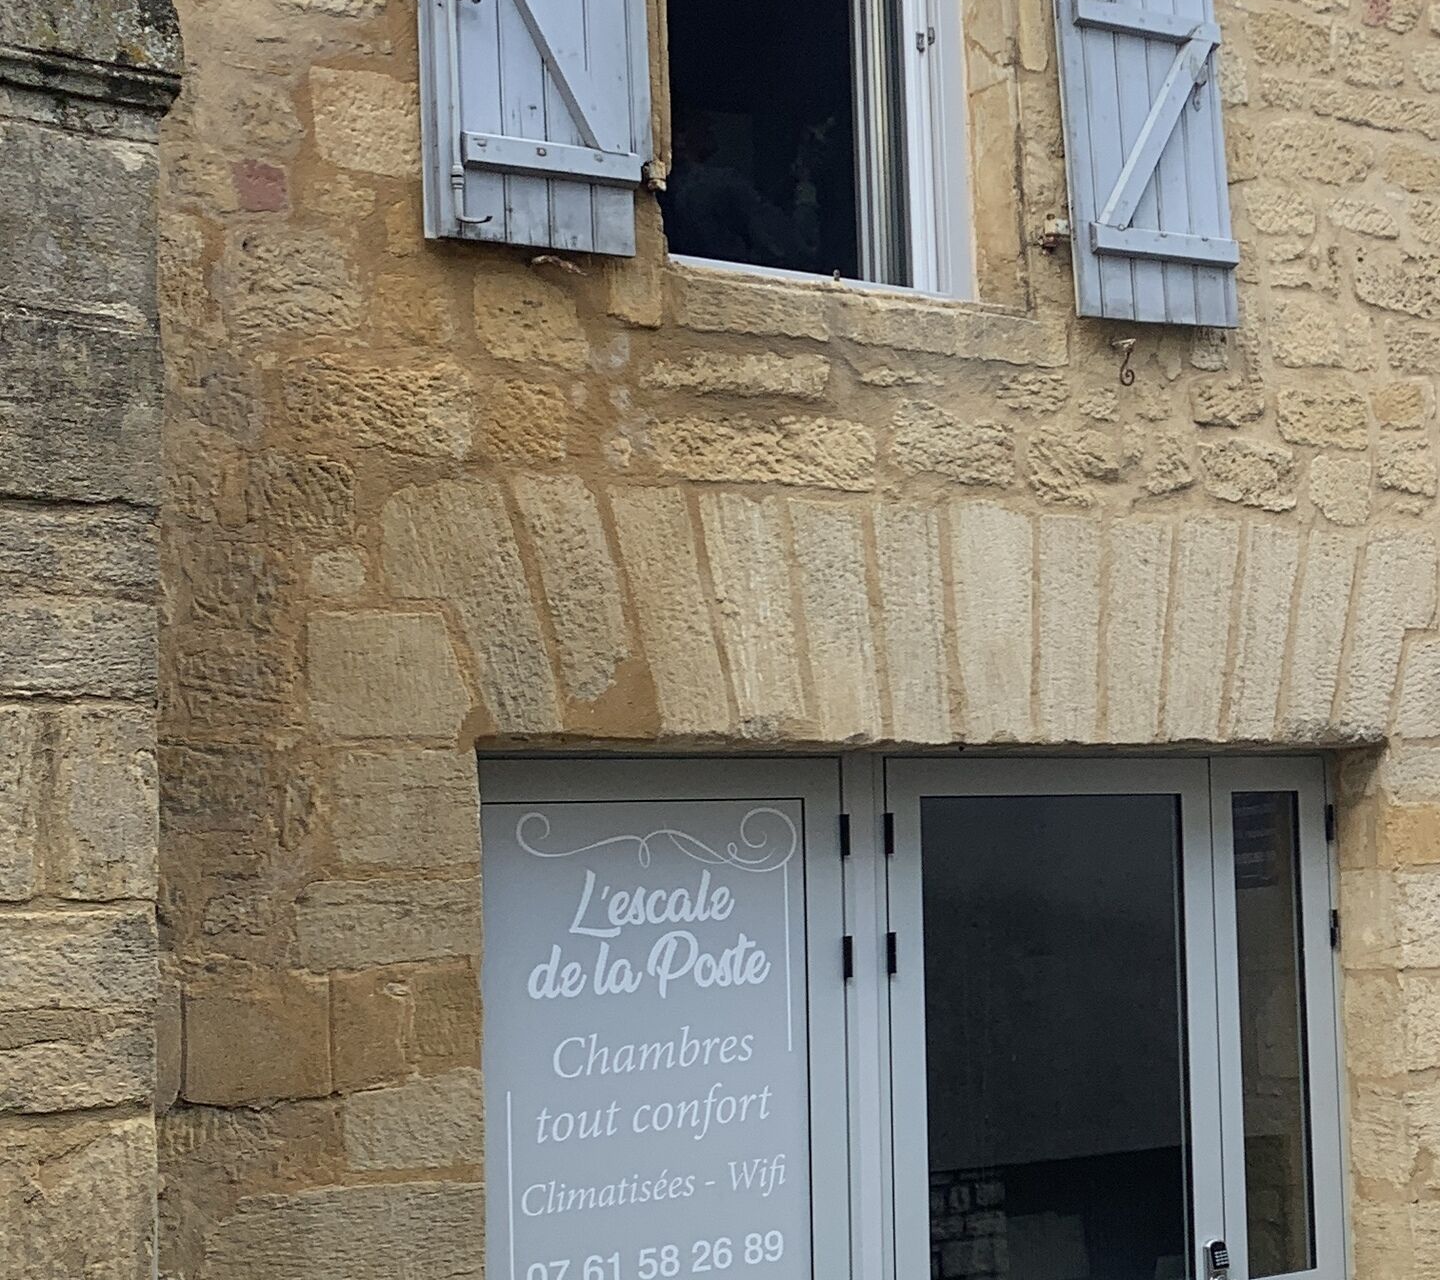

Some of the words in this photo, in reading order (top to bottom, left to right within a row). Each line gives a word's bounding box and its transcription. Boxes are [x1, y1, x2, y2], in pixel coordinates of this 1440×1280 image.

[568, 870, 734, 937] L'escale
[527, 945, 587, 999] de
[594, 941, 641, 995] la
[647, 930, 771, 999] Poste
[553, 1026, 753, 1079] Chambres
[536, 1100, 621, 1144] tout
[632, 1083, 772, 1140] confort
[521, 1170, 696, 1217] Climatisées
[728, 1154, 786, 1197] Wifi
[637, 1245, 680, 1280] 58
[691, 1236, 733, 1272] 26
[744, 1230, 784, 1265] 89
